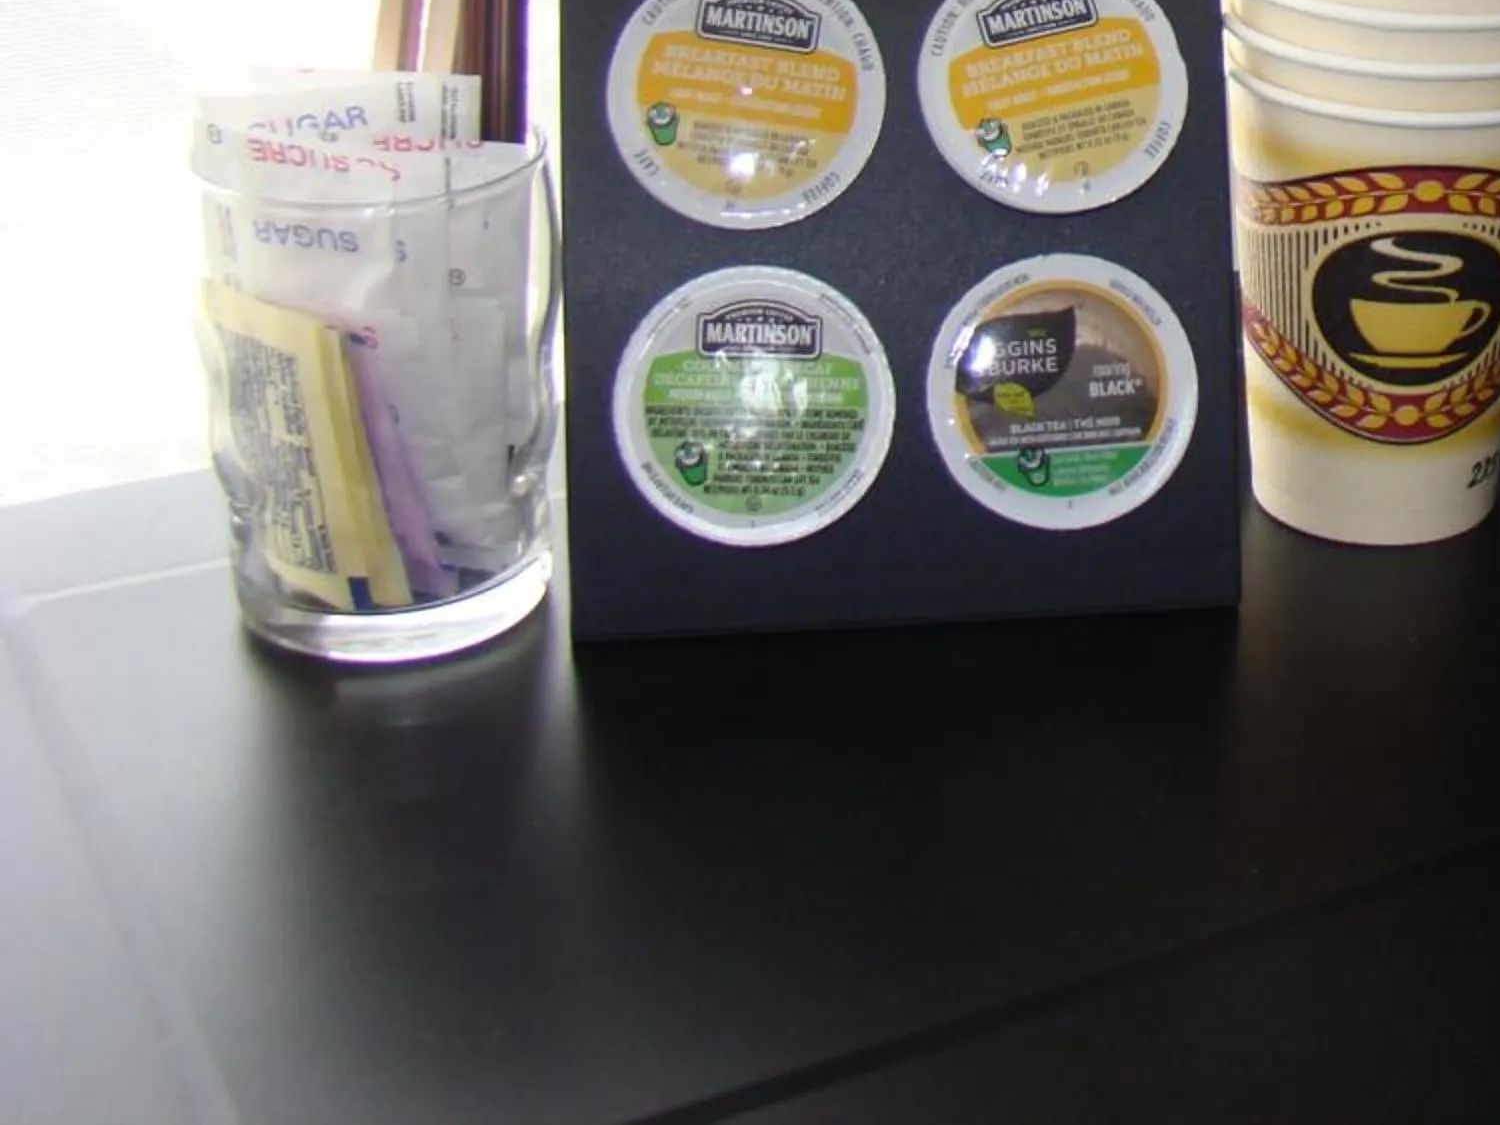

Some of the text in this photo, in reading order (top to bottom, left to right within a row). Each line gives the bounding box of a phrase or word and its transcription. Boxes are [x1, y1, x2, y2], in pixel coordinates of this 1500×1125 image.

[706, 4, 810, 40] MARTINSON
[252, 220, 360, 254] SUGAR
[706, 321, 812, 346] MARTINSON
[990, 355, 1060, 376] BURKE
